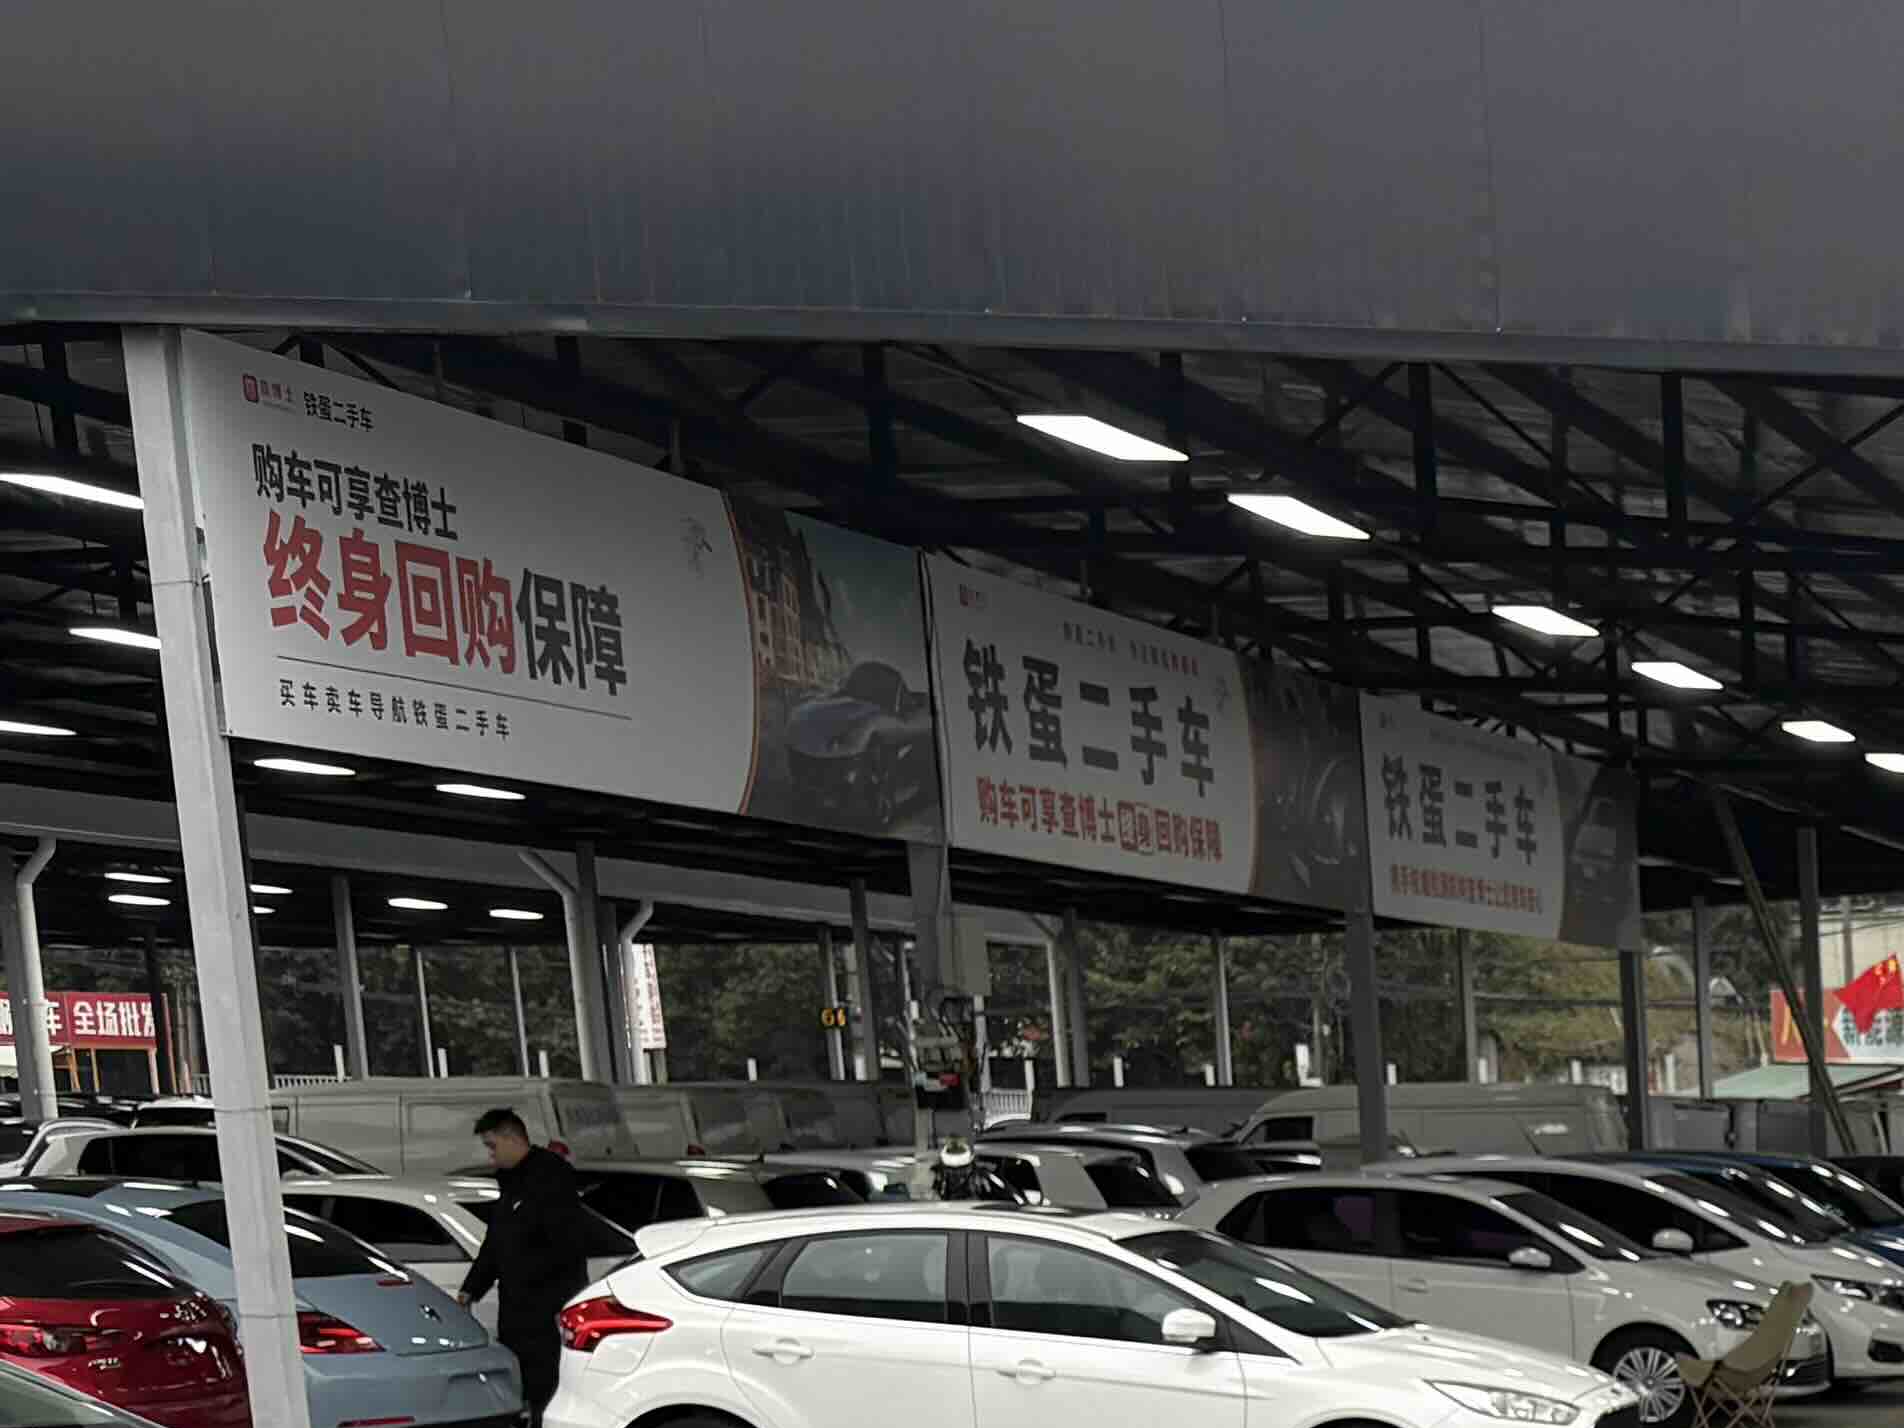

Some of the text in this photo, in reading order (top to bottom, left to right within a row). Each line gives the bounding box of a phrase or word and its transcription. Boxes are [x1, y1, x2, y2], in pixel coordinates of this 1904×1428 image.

[303, 391, 373, 432] 铁蛋二手车
[252, 443, 458, 540] 购车可享查博士
[263, 508, 627, 696] 终身回购保障
[963, 638, 1214, 798] 铁蛋二手车
[1382, 752, 1537, 866] 铁蛋二手车
